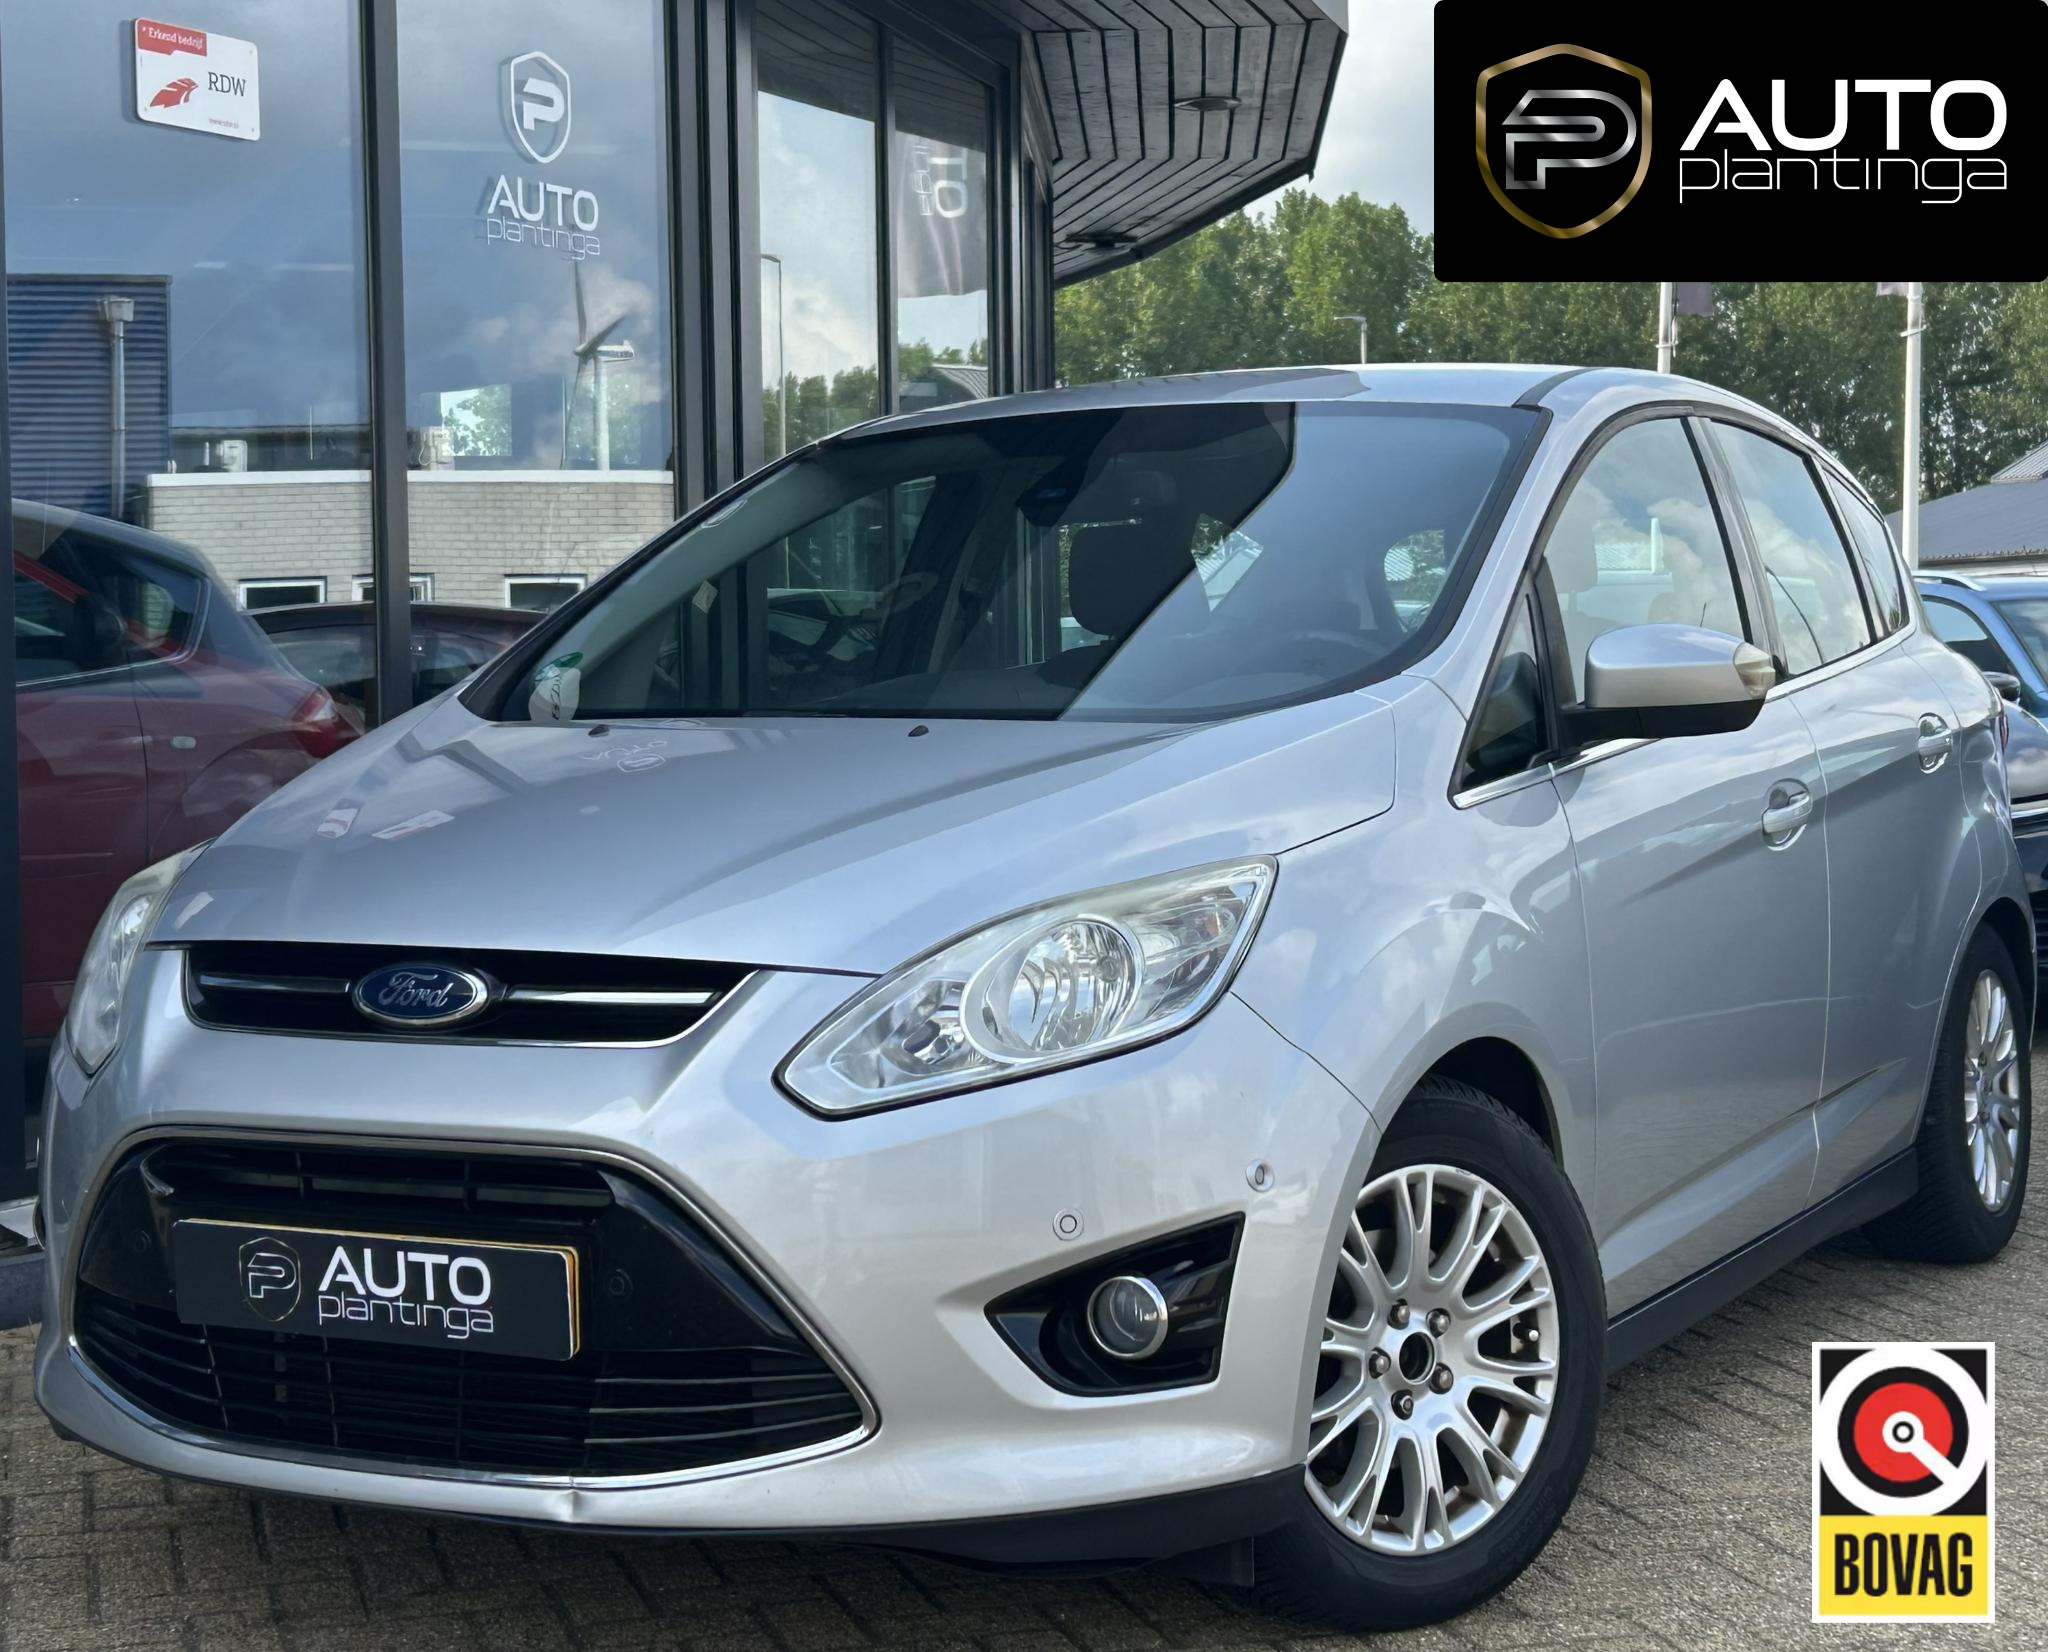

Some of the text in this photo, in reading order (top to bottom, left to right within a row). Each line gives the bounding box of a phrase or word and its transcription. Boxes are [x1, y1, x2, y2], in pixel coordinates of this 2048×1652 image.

[207, 71, 246, 97] RDW
[488, 174, 599, 231] AUTO
[487, 215, 600, 260] plantinga
[378, 971, 454, 1008] Ford
[318, 1245, 491, 1305] AUTO
[318, 1291, 494, 1340] plantinga
